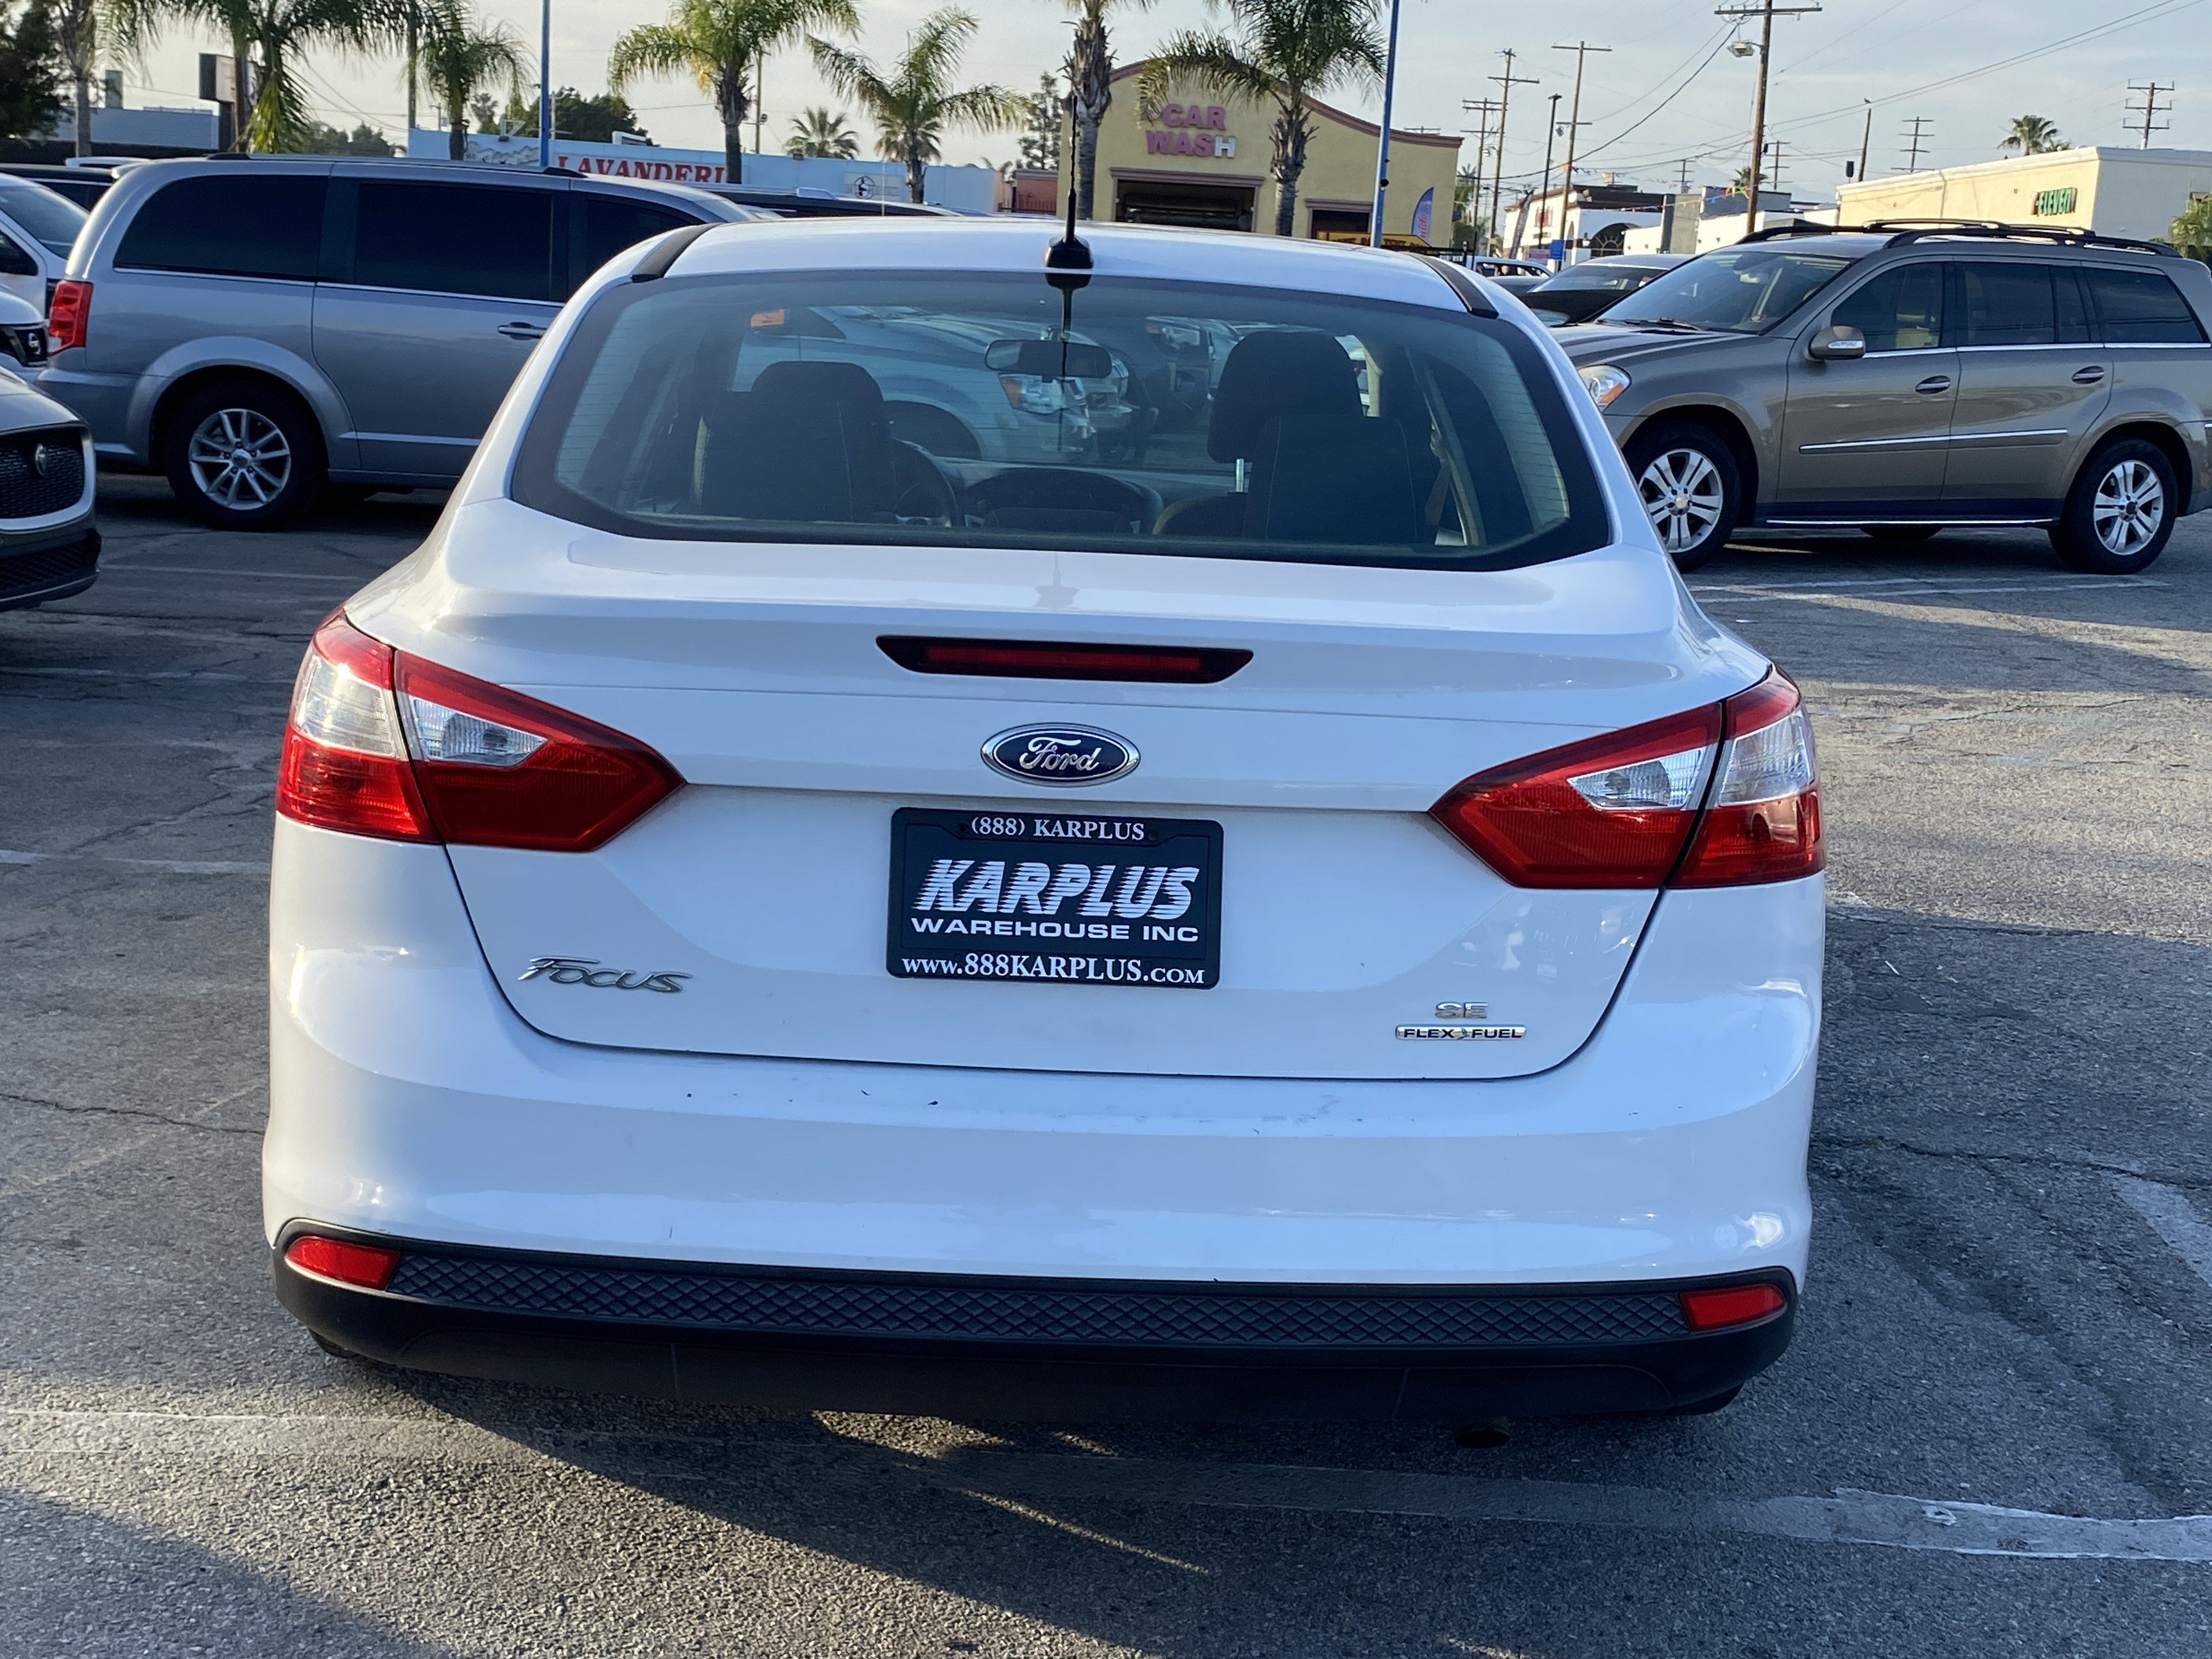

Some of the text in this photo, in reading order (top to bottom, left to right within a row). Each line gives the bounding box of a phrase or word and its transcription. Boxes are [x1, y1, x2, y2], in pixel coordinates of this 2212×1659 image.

[1161, 103, 1226, 131] CAR
[1146, 129, 1236, 159] WASH
[1019, 737, 1102, 771] Ford
[971, 817, 1145, 840] (888) KARPLUS
[912, 859, 1200, 921] KARPLUS
[911, 918, 1199, 943] WAREHOUSE INC
[1435, 1002, 1488, 1019] SE
[1403, 1028, 1522, 1039] FLEX FUEL
